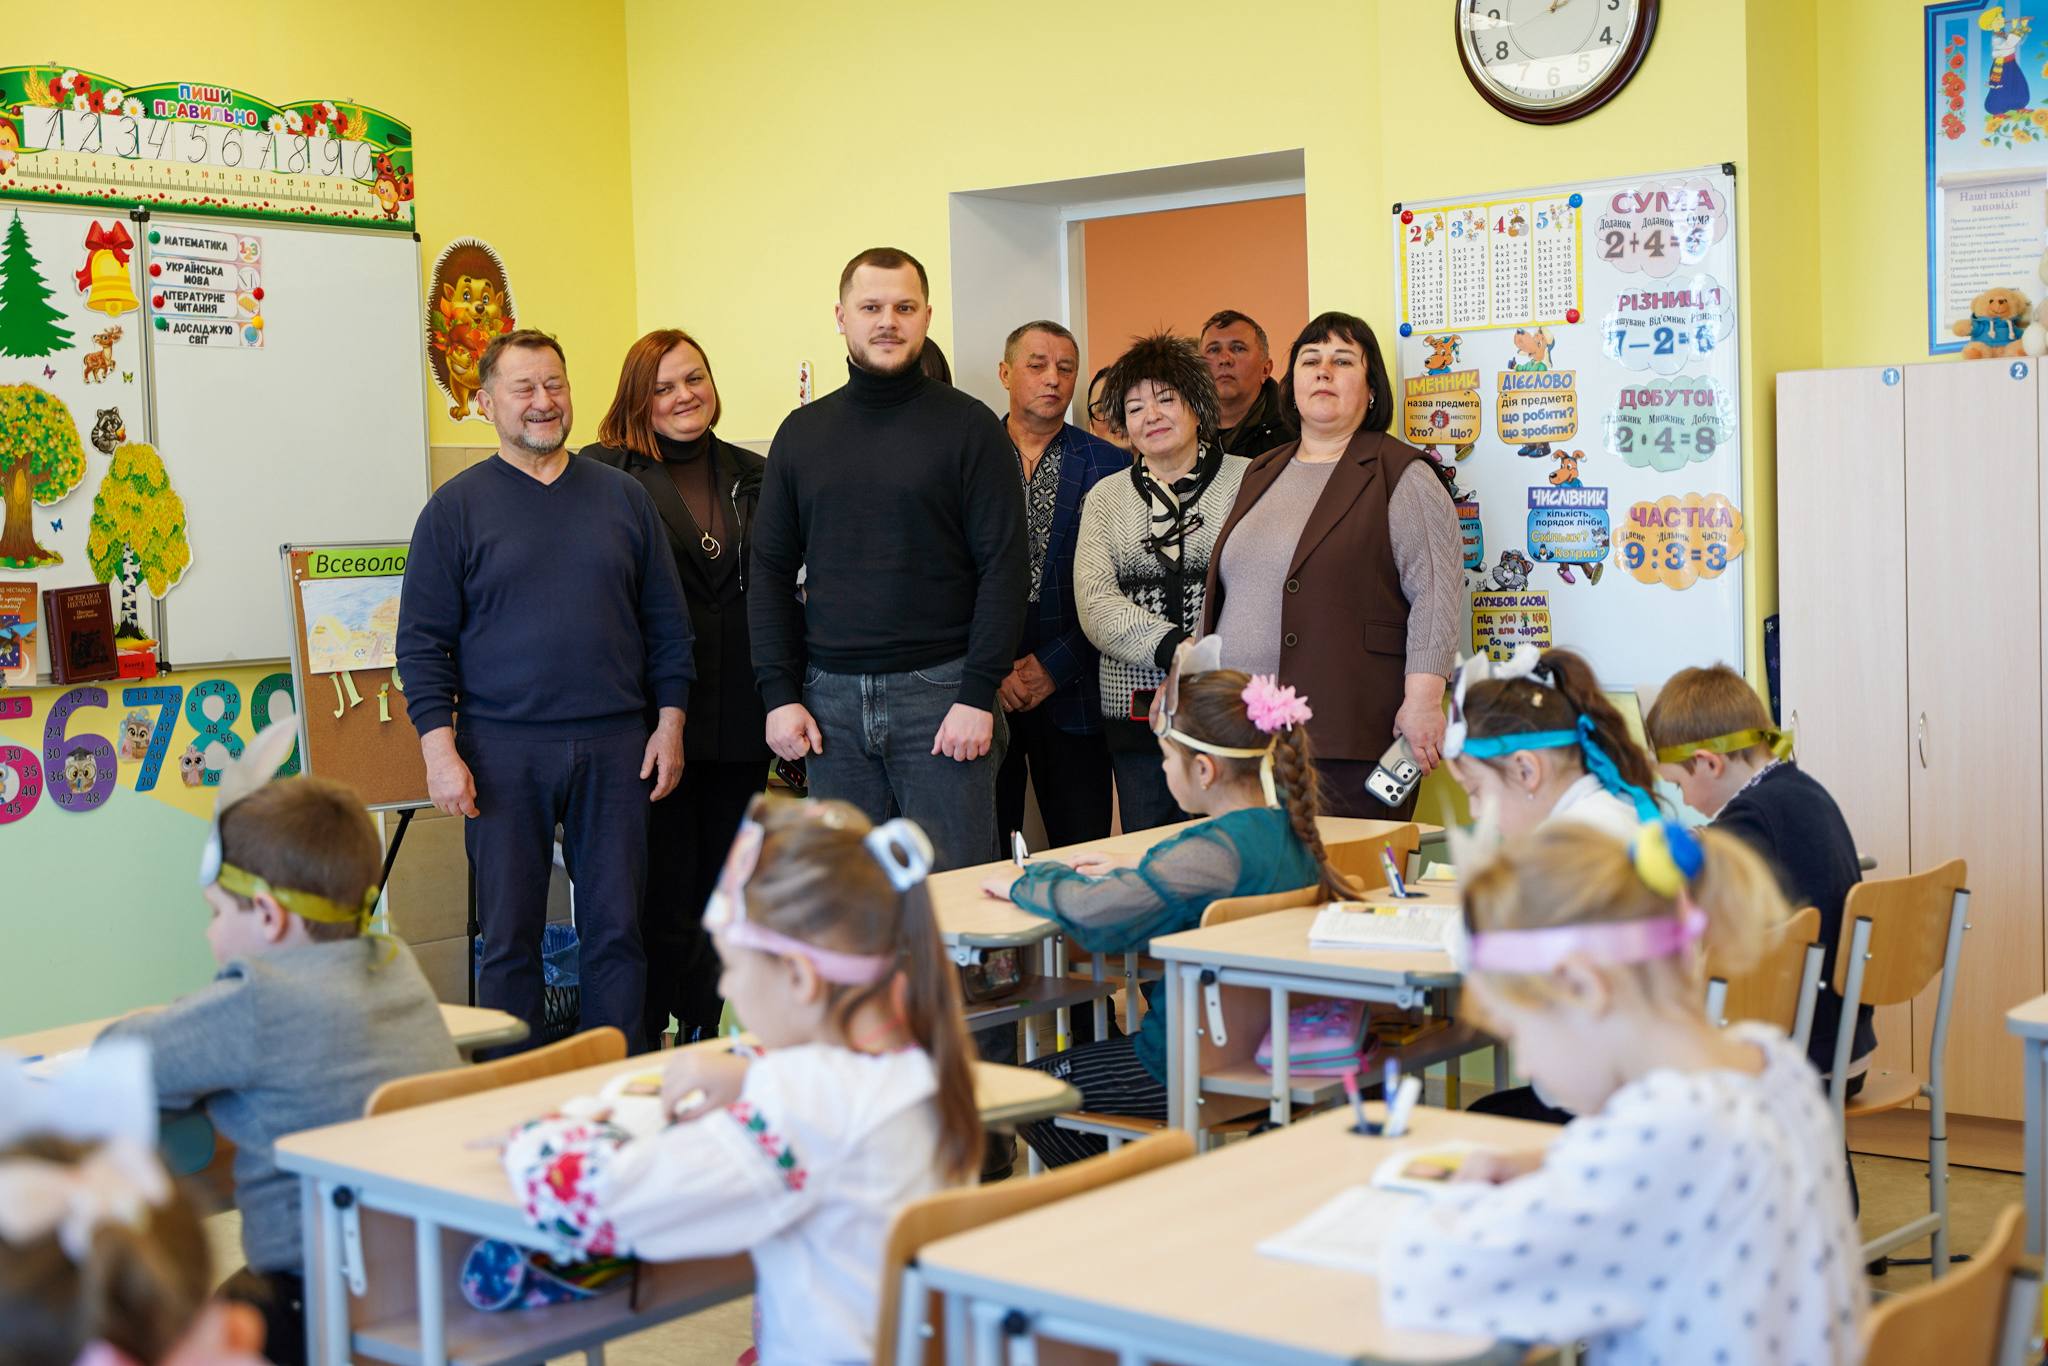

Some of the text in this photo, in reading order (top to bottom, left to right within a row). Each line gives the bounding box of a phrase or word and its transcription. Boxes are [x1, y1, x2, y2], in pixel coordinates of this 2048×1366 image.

[1600, 27, 1613, 45] 4
[1496, 41, 1509, 60] 8
[1577, 54, 1590, 74] 5
[1517, 62, 1531, 82] 7
[1549, 67, 1561, 87] 6
[178, 84, 232, 105] ПИШИ
[153, 99, 258, 127] ПРАВИЛЬНО
[46, 109, 372, 179] 1 2 3 4 5 6 7 8 9 0
[111, 162, 117, 170] 5
[218, 172, 225, 180] 11
[253, 175, 260, 183] 13
[1410, 211, 1549, 243] 2 3 4 5
[1599, 218, 1632, 230] Доданок
[1641, 216, 1674, 229] Доданок
[164, 235, 228, 251] МАТЕМАТИКА
[165, 262, 224, 276] УКРАЇНСЬКА
[184, 275, 210, 286] МОВА
[162, 290, 225, 303] ЛІТЕРАТУРНЕ
[174, 303, 217, 313] ЧИТАННЯ
[173, 323, 233, 335] ДОСЛІДЖУЮ
[189, 335, 209, 345] СВІТ
[1888, 370, 1896, 383] 1
[2014, 364, 2024, 377] 2
[1408, 371, 1478, 395] ІМЕННИК
[1502, 373, 1573, 390] ДІЄСЛОВО
[1435, 400, 1479, 409] предмета
[1502, 394, 1573, 408] дія предмета
[1502, 406, 1574, 424] що робити?
[1410, 427, 1473, 439] Хто? Що?
[1503, 423, 1575, 439] що зробити?
[1532, 489, 1606, 507] ЧИСЛІВНИК
[1536, 518, 1603, 527] порядок лічби
[1630, 506, 1733, 528] ЧАСТКА
[316, 554, 406, 573] Всеволо
[1473, 595, 1547, 607] СЛУЖБОВІ СЛОВА
[1477, 614, 1493, 625] під
[1476, 627, 1494, 636] над
[1518, 625, 1549, 637] через
[1489, 636, 1501, 646] бо
[1504, 641, 1516, 649] чи
[194, 687, 207, 697] 16
[213, 683, 226, 693] 24
[69, 693, 83, 704] 12
[92, 693, 100, 703] 6
[136, 691, 148, 701] 14
[153, 691, 165, 699] 21
[168, 693, 181, 704] 28
[226, 693, 238, 704] 32
[14, 702, 22, 712] 5
[53, 706, 68, 718] 18
[163, 707, 175, 717] 35
[190, 702, 197, 712] 8
[253, 705, 265, 715] 18
[222, 711, 235, 721] 40
[46, 726, 61, 738] 24
[158, 722, 170, 732] 42
[205, 724, 218, 734] 48
[154, 736, 166, 746] 49
[220, 733, 233, 743] 56
[6, 748, 21, 761] 30
[46, 747, 61, 759] 30
[94, 745, 109, 756] 60
[23, 765, 38, 777] 35
[49, 770, 64, 782] 36
[207, 772, 220, 782] 80
[21, 784, 37, 796] 40
[59, 793, 73, 805] 42
[85, 792, 100, 804] 48
[6, 802, 21, 814] 45
